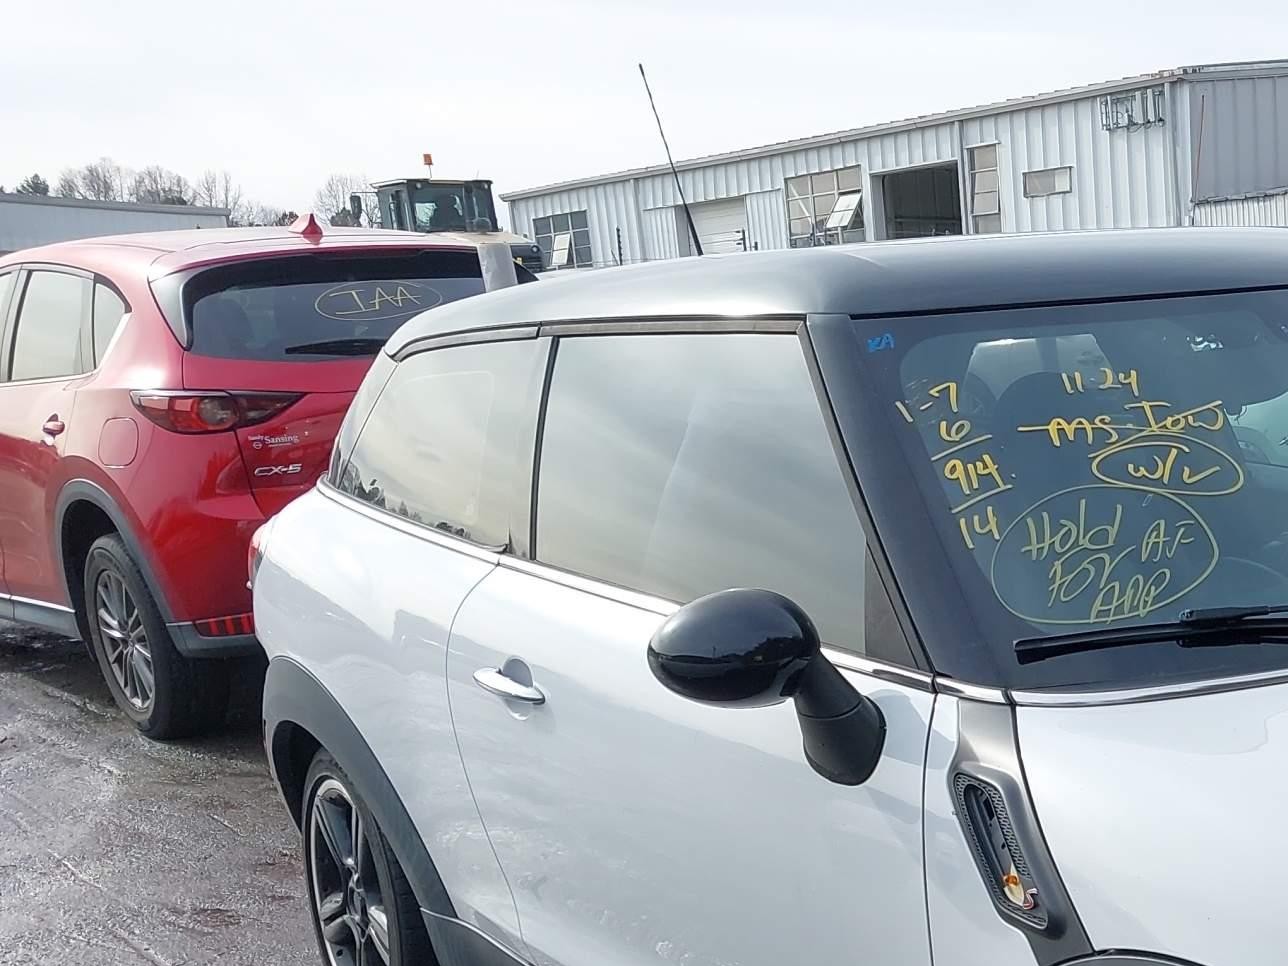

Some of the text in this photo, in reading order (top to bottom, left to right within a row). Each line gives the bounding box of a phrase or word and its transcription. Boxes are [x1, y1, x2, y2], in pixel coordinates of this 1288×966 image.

[329, 286, 421, 315] IAA
[254, 463, 302, 476] CX-5
[944, 454, 1005, 495] 914
[960, 506, 1000, 549] 14
